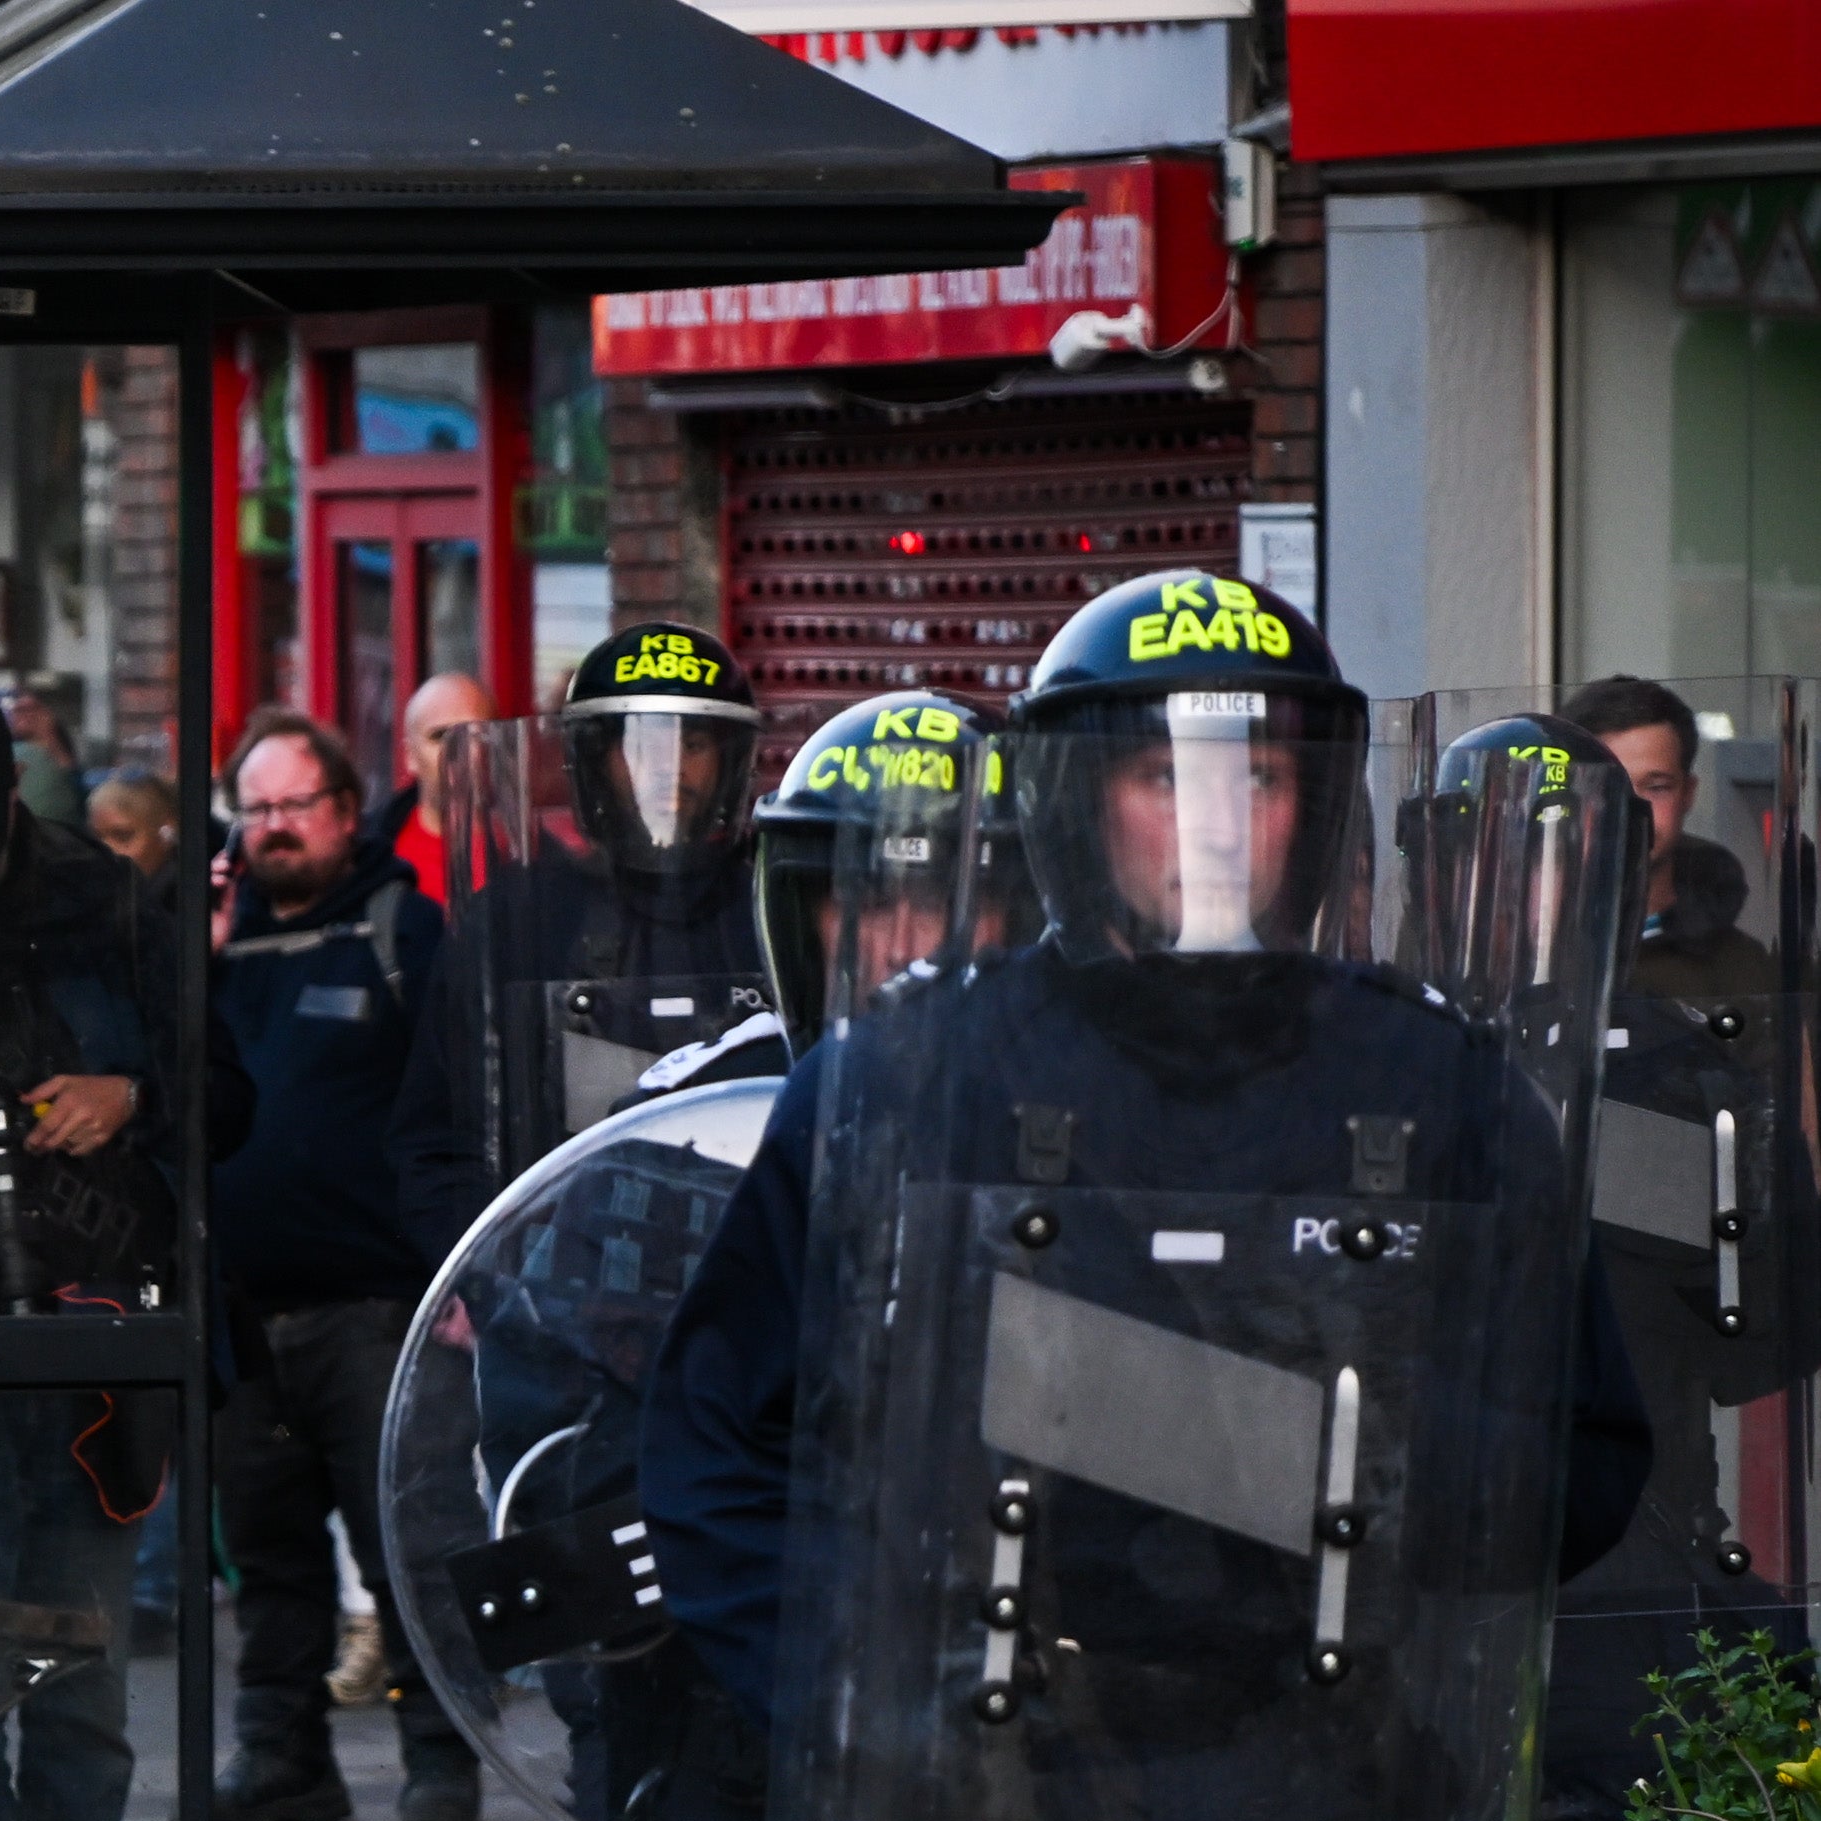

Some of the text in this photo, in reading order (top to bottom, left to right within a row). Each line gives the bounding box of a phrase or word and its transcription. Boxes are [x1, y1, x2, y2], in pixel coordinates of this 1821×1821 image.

[1160, 578, 1258, 613] KB
[640, 634, 694, 655] KB
[1128, 608, 1292, 662] EA419
[614, 652, 721, 687] EA867
[1190, 693, 1255, 712] POLICE
[873, 706, 959, 742] KB
